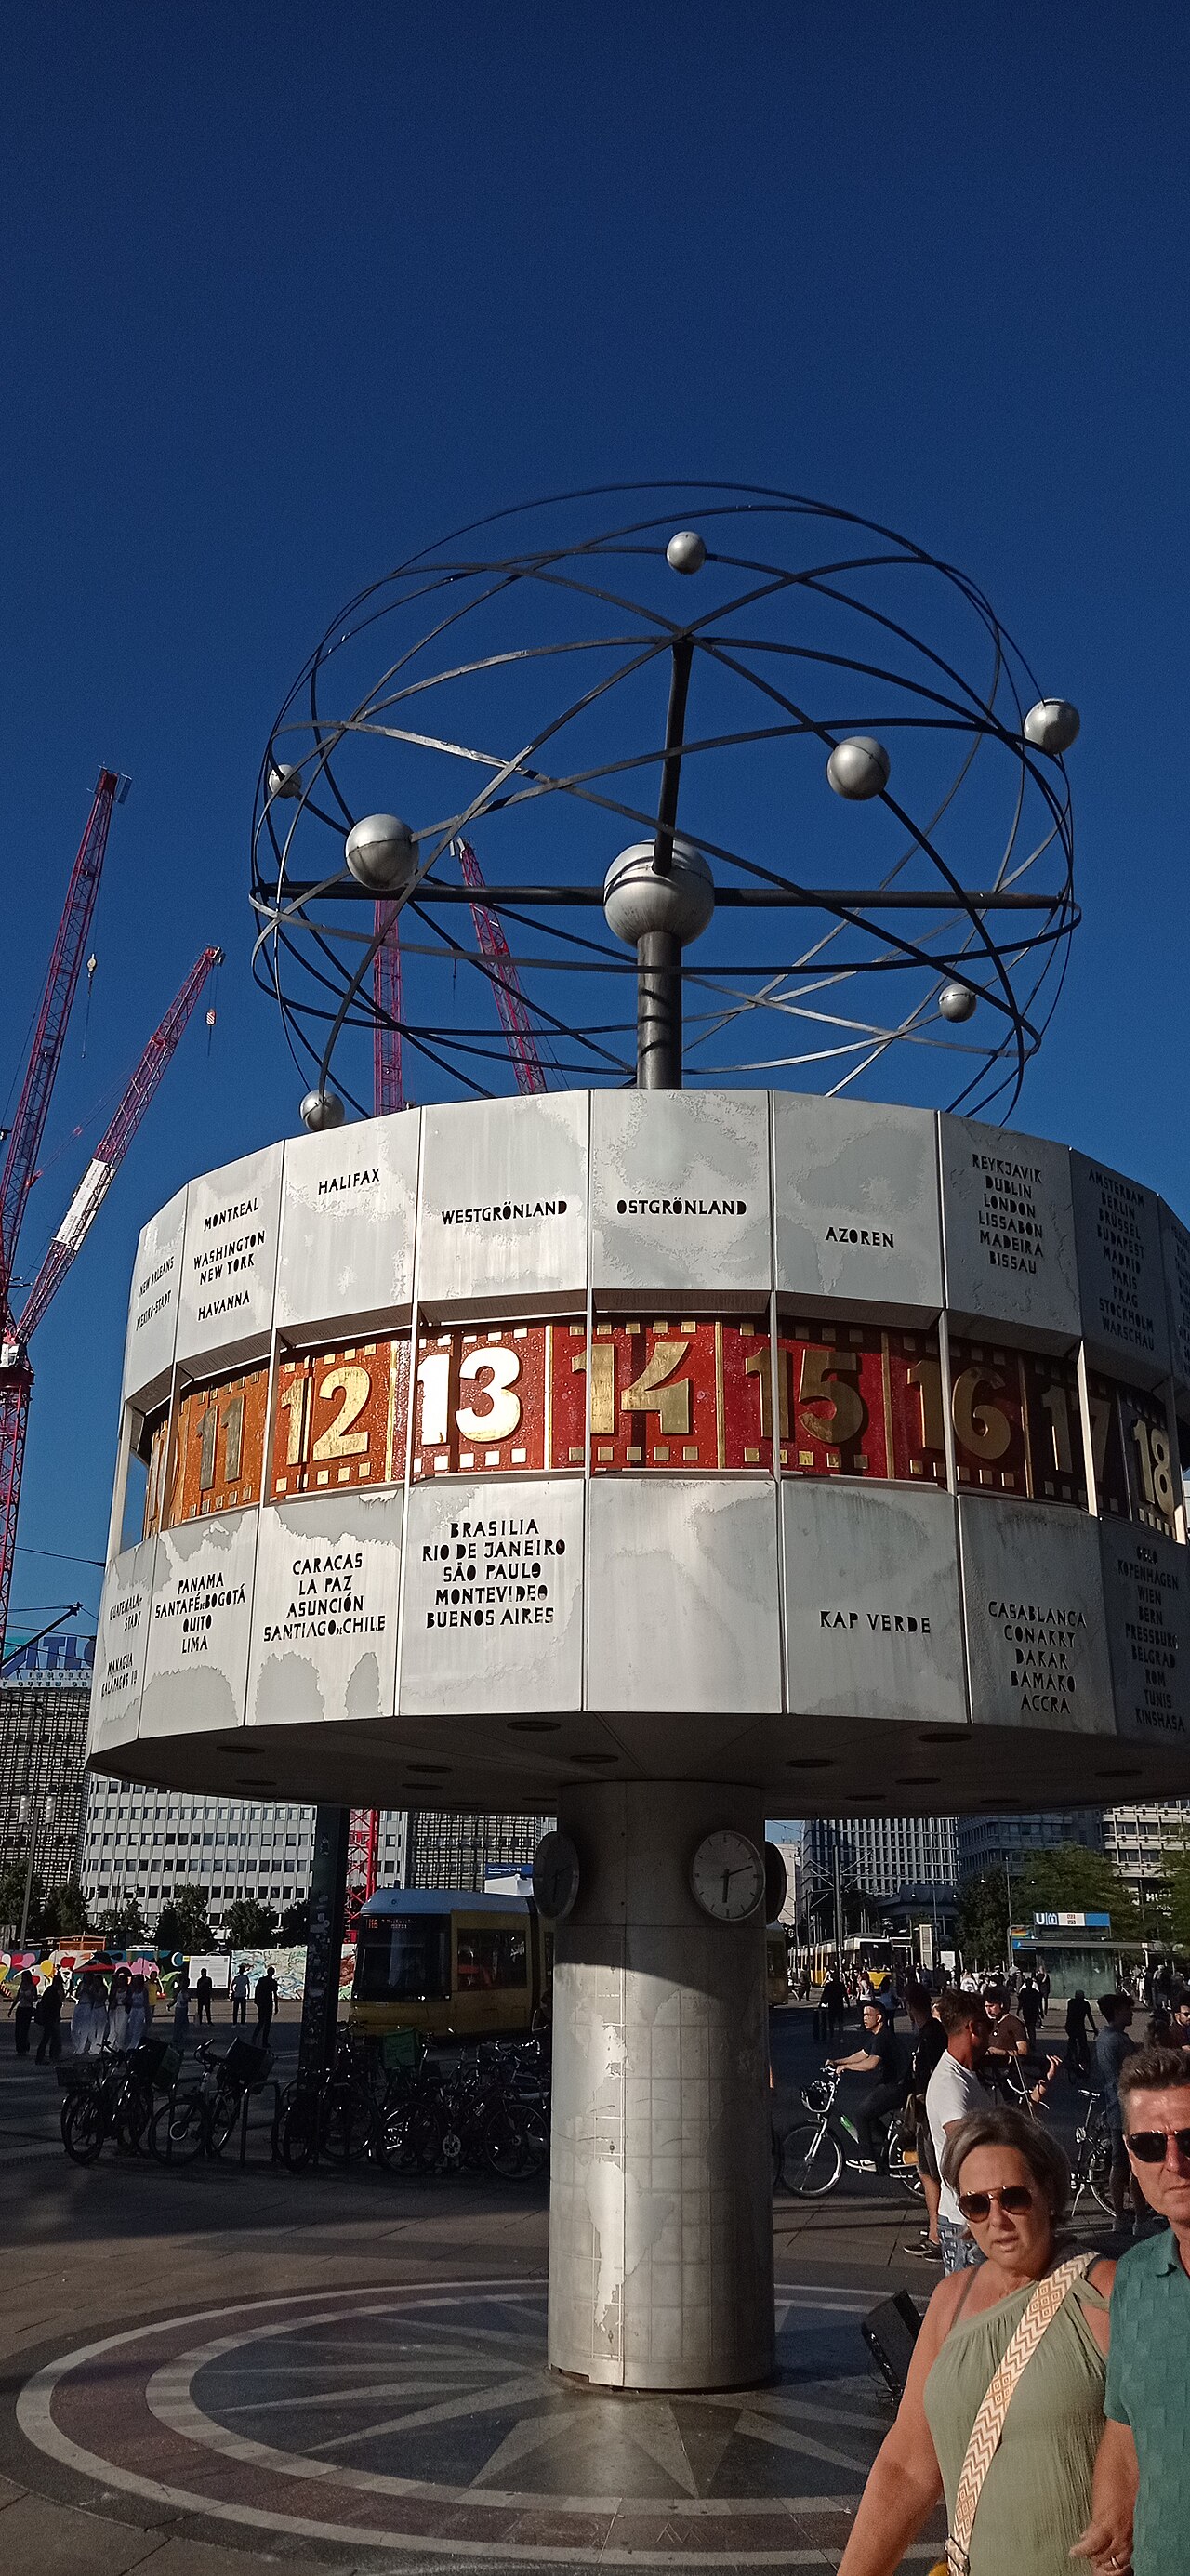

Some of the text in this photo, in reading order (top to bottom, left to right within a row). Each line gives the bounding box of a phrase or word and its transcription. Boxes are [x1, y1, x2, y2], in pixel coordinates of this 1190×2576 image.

[972, 1154, 1041, 1184] REYKJAVIK
[318, 1168, 380, 1195] HALIFAX
[985, 1175, 1032, 1199] DUBLIN
[1089, 1169, 1144, 1209] AMSTERDAM
[204, 1197, 259, 1231] MONTREAL
[442, 1201, 567, 1225] WESTGRÖNLAND
[616, 1196, 747, 1215] OSTGRÖNLAND
[984, 1193, 1036, 1219] LONDON
[1101, 1192, 1135, 1220] BERLIN
[978, 1210, 1043, 1238] LISSABON
[1099, 1208, 1141, 1240] BRÜSSEL
[825, 1226, 894, 1248] AZOREN
[980, 1230, 1044, 1257] MADEIRA
[1097, 1224, 1144, 1259] BUDAPEST
[193, 1230, 265, 1270] WASHINGTON
[1104, 1245, 1141, 1274] MADRID
[200, 1253, 255, 1286] NEW YORK
[989, 1251, 1037, 1275] BISSAU
[139, 1276, 151, 1297] NEW
[1112, 1267, 1137, 1289] PARIS
[198, 1290, 250, 1321] HAVANNA
[1114, 1286, 1138, 1308] PRAG
[1099, 1298, 1154, 1332] STOCKHOLM
[1102, 1316, 1155, 1351] WARSCHAU
[417, 1347, 521, 1446] 13
[571, 1341, 690, 1434] 14
[746, 1347, 863, 1443] 15
[280, 1366, 371, 1466] 12
[907, 1359, 1011, 1460] 16
[196, 1395, 245, 1490] 11
[1043, 1384, 1112, 1483] 17
[1133, 1420, 1175, 1515] 18
[451, 1519, 539, 1538] BRASILIA
[422, 1539, 566, 1562] RIO DE JANEIRO
[293, 1553, 363, 1575] CARACAS
[486, 1562, 541, 1580] PAULO
[1117, 1560, 1179, 1591] KOPENHAGEN
[178, 1572, 224, 1595] PANAMA
[299, 1575, 352, 1595] LA PAZ
[435, 1584, 548, 1605] MONTEVIDEO
[1137, 1585, 1162, 1605] WIEN
[286, 1592, 364, 1618] ASUNCIÓN
[988, 1601, 1087, 1628] CASABLANCA
[1139, 1606, 1163, 1626] BERN
[182, 1615, 212, 1633] QUITO
[426, 1607, 554, 1629] BUENOS AIRES
[820, 1611, 931, 1634] KAP VERDE
[182, 1635, 208, 1654] LIMA
[1004, 1625, 1076, 1648] CONAKRY
[1125, 1623, 1178, 1649] PRESSBURG
[1015, 1649, 1068, 1670] DAKAR
[1131, 1645, 1176, 1668] BELGRAD
[1011, 1670, 1075, 1693] BAMAKO
[1145, 1669, 1166, 1687] ROM
[1021, 1693, 1071, 1714] ACCRA
[1144, 1689, 1172, 1709] TUNIS
[1135, 1708, 1185, 1732] KINSHASA
